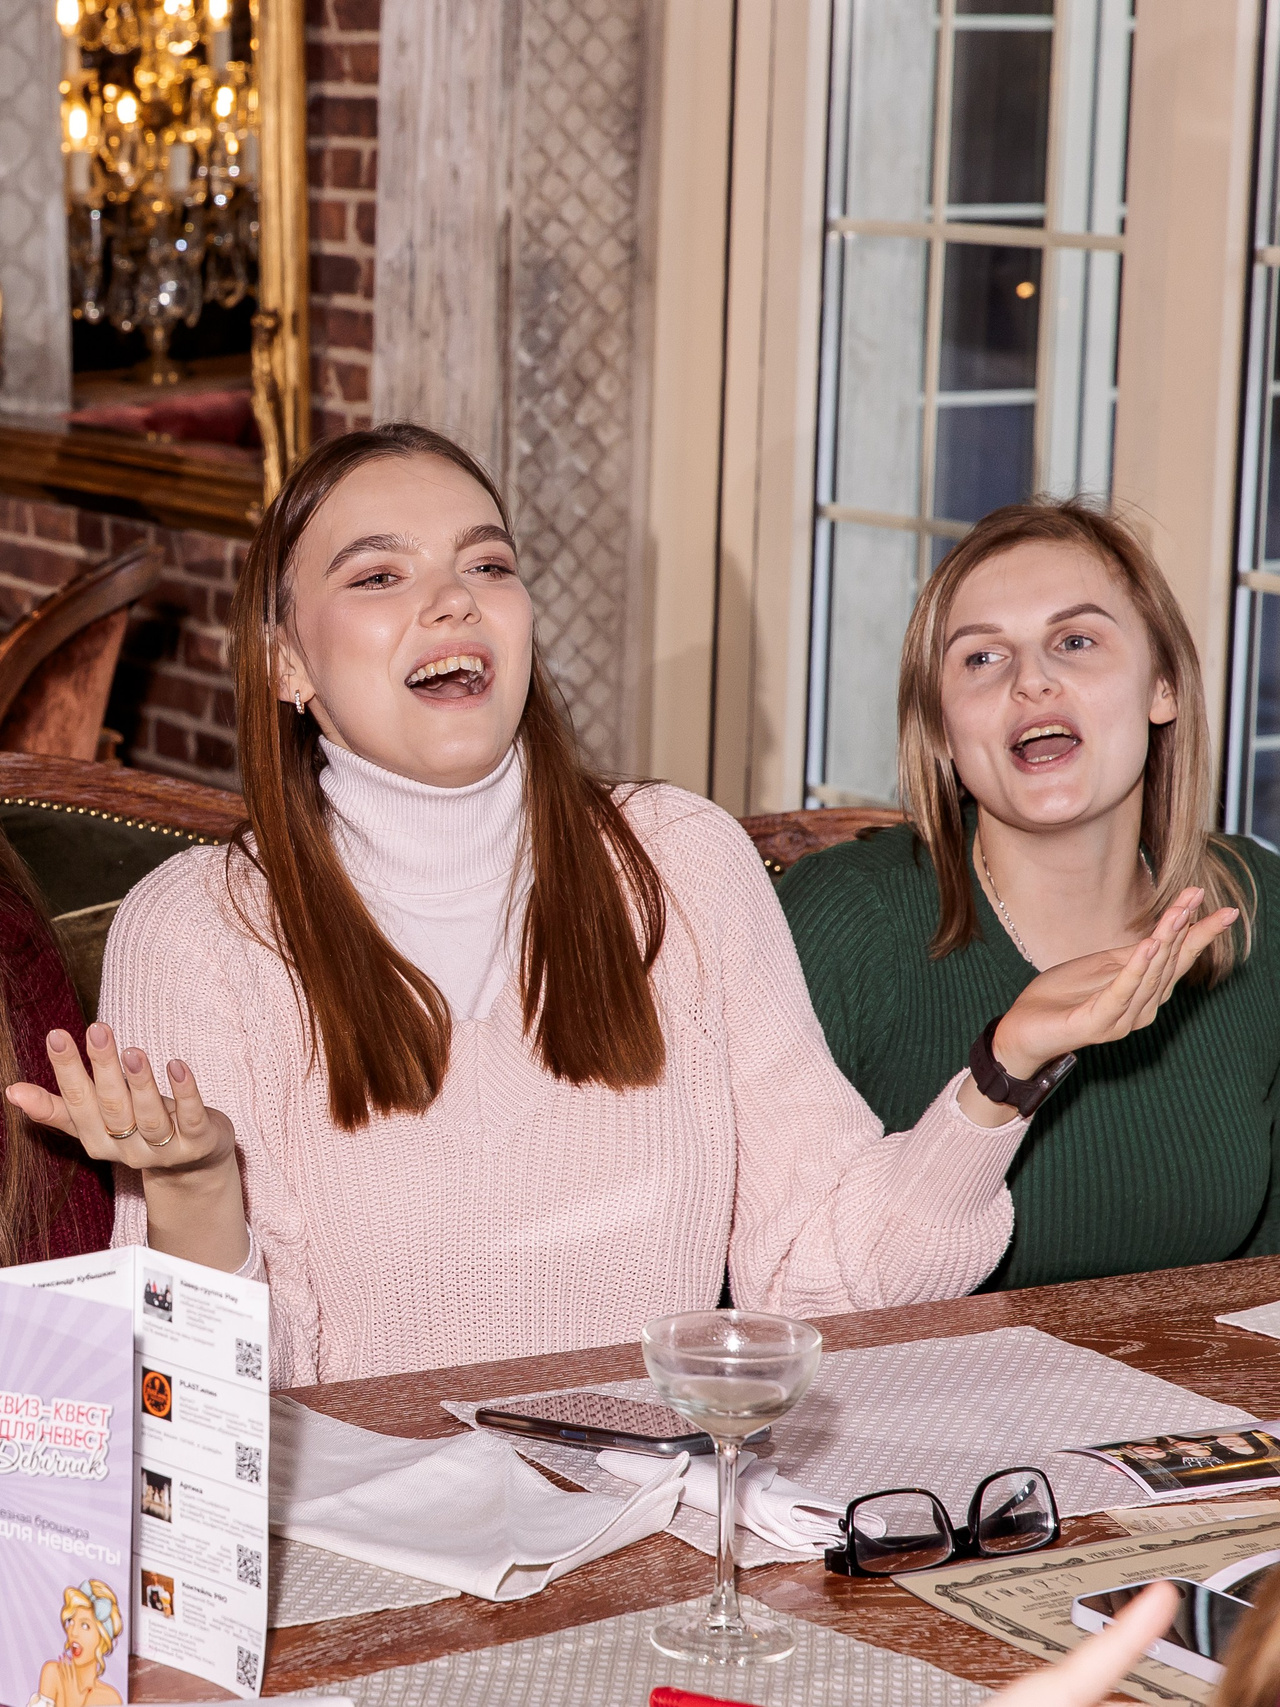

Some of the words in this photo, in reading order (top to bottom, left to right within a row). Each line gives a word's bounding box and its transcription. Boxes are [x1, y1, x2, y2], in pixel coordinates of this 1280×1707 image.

[39, 1423, 107, 1451] НЕВЕСТ
[34, 1514, 90, 1541] брошюра
[37, 1529, 121, 1566] невесты
